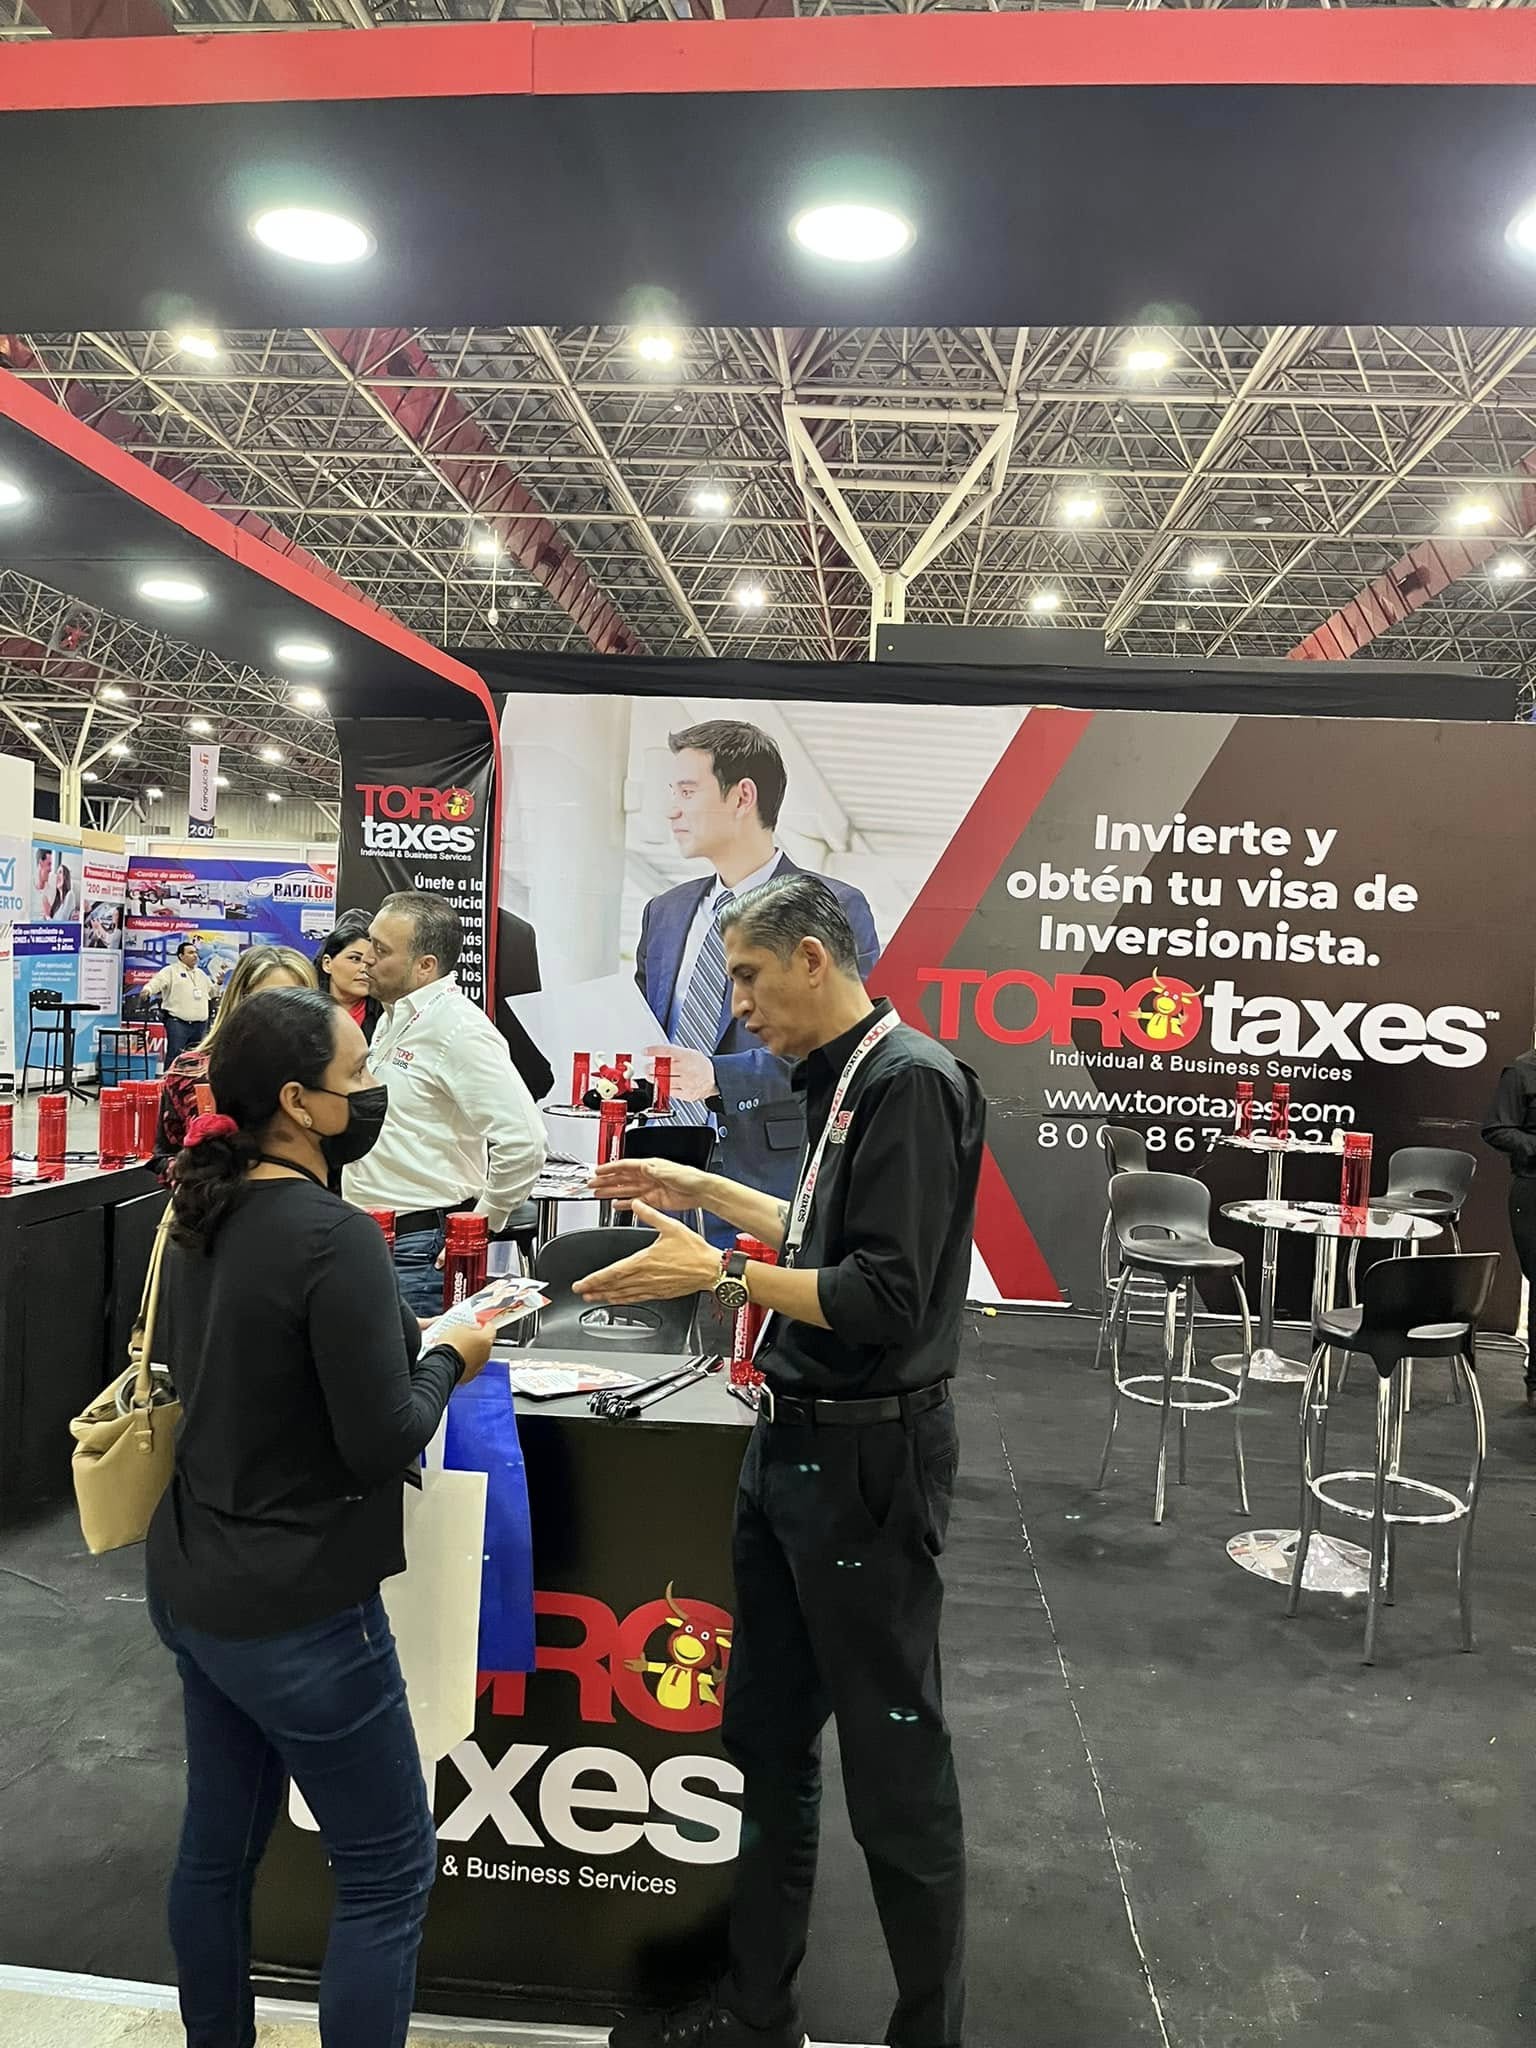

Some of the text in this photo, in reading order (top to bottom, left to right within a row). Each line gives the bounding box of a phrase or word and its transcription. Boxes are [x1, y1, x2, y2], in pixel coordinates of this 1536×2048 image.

[355, 784, 475, 821] TORO
[189, 825, 214, 837] 200
[361, 816, 475, 853] taxes
[1094, 813, 1337, 866] Invierte y
[360, 848, 472, 862] Individual & Business Services
[414, 872, 483, 892] Únete a la
[1006, 863, 1419, 913] obtén tu visa de
[1039, 916, 1380, 966] Inversionista.
[463, 968, 482, 982] los
[917, 967, 1203, 1052] TORO
[1204, 979, 1488, 1069] taxes
[1050, 1050, 1353, 1082] Individual & Business Services
[1044, 1088, 1355, 1125] www.torotaxes.com
[476, 1590, 735, 1733] RO
[443, 1855, 677, 1896] & Business Services
